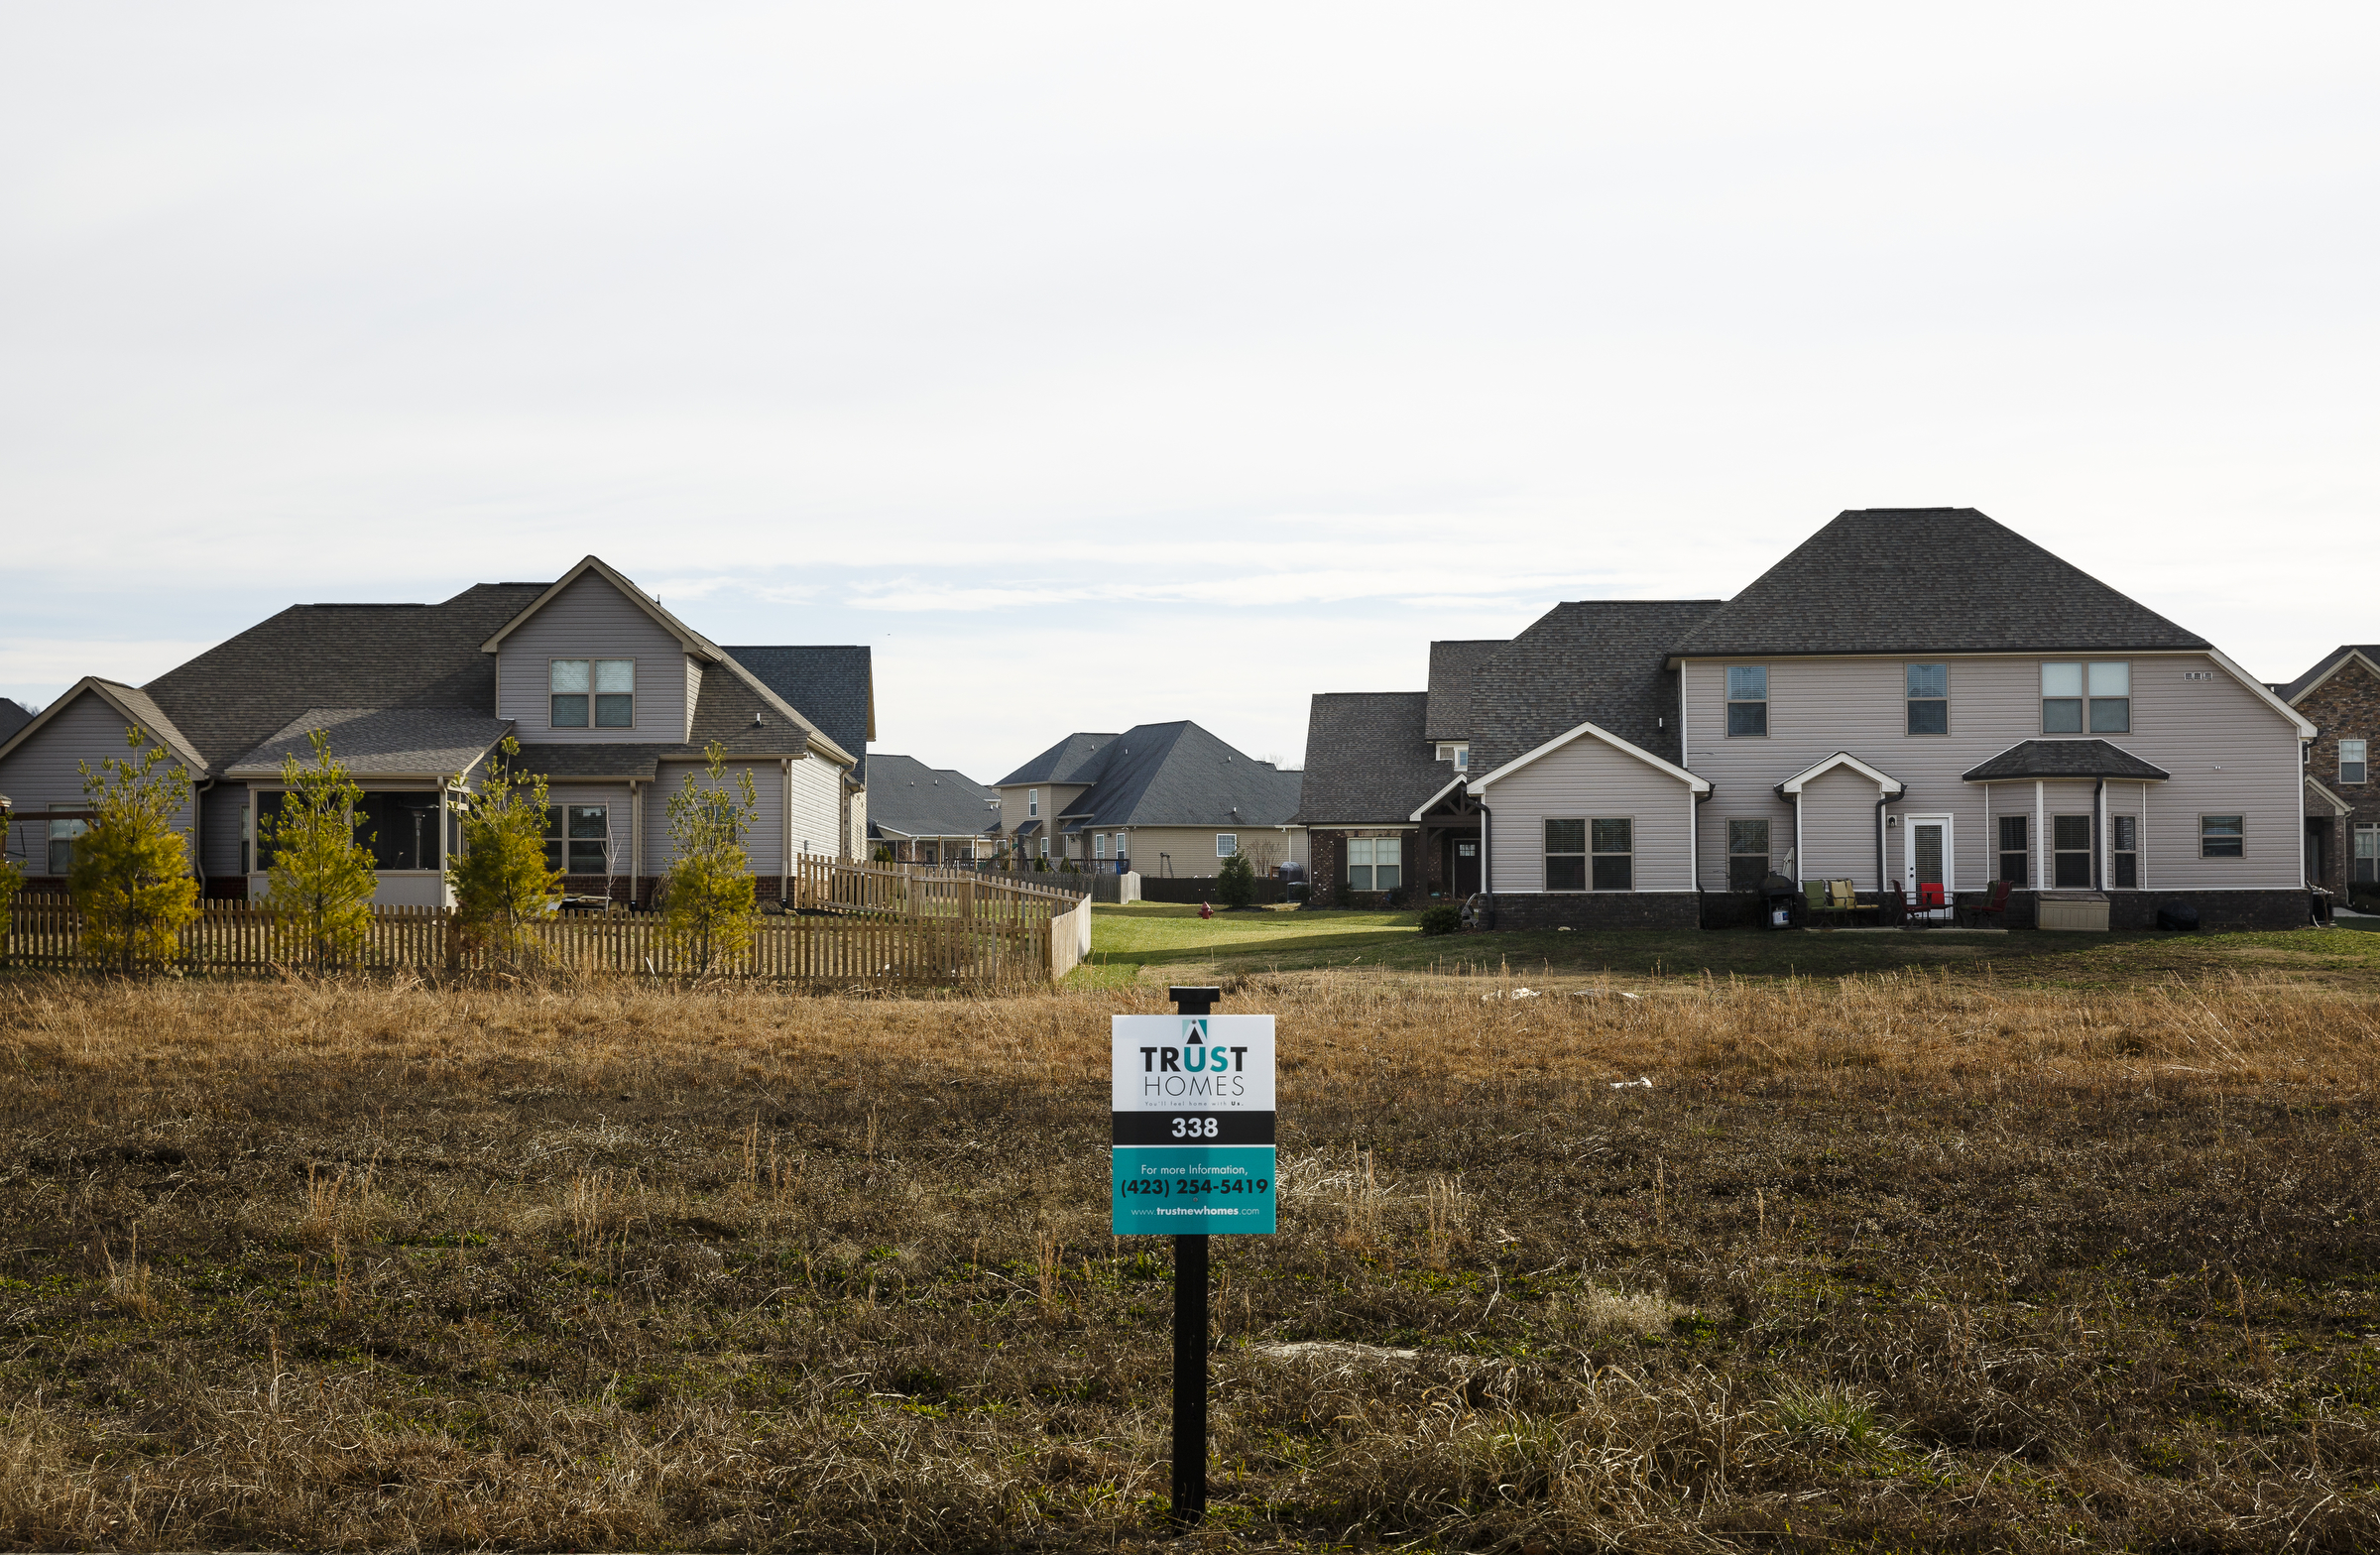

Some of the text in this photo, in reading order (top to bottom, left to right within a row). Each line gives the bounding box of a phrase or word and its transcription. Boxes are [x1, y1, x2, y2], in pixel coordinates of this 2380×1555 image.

[1139, 1046, 1249, 1072] TRUST
[1144, 1075, 1245, 1097] HOMES
[1171, 1117, 1219, 1138] 338
[1141, 1164, 1249, 1176] For more Information,
[1121, 1178, 1268, 1198] (423) 254-5419
[1130, 1206, 1259, 1216] www.trustnewhomes.com
